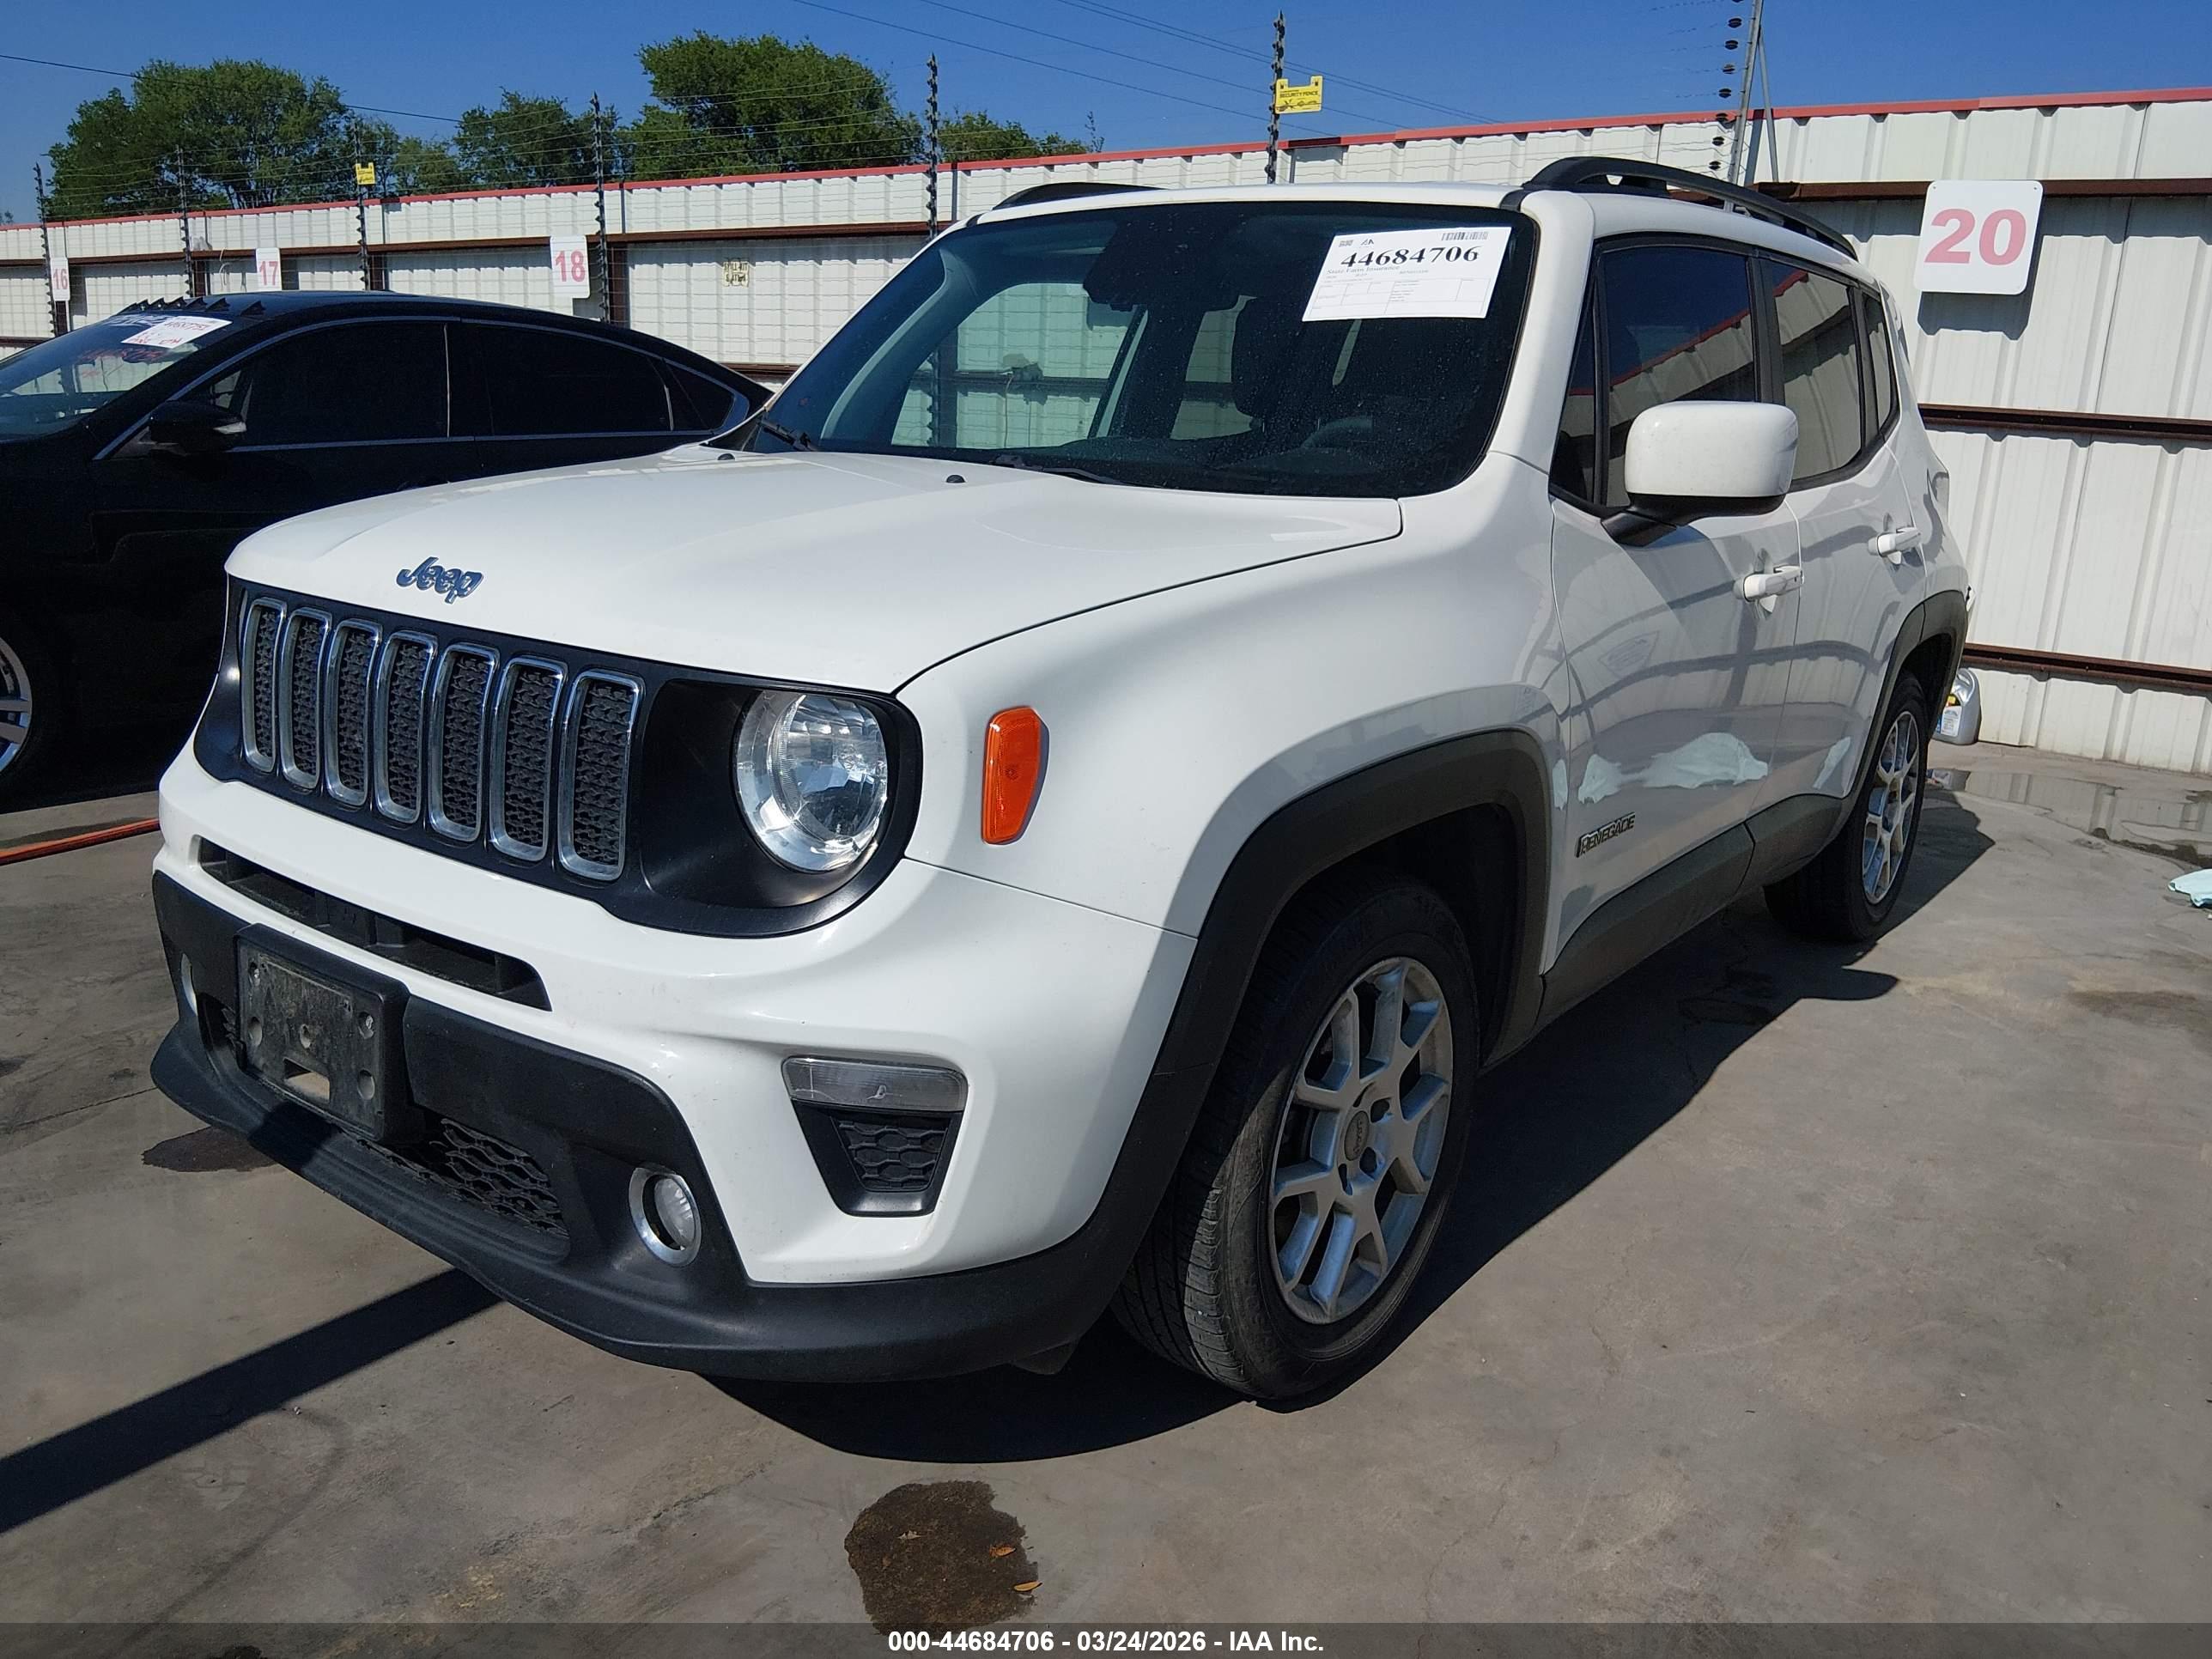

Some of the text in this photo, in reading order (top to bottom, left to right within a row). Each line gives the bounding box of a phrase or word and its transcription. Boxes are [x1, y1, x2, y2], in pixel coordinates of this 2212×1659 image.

[1923, 208, 2027, 266] 20
[259, 260, 278, 286] 17
[555, 250, 586, 283] 18
[1340, 246, 1481, 268] 44684706
[52, 268, 69, 290] 16
[396, 556, 484, 605] Jeep
[1576, 811, 1636, 858] RENEGADE
